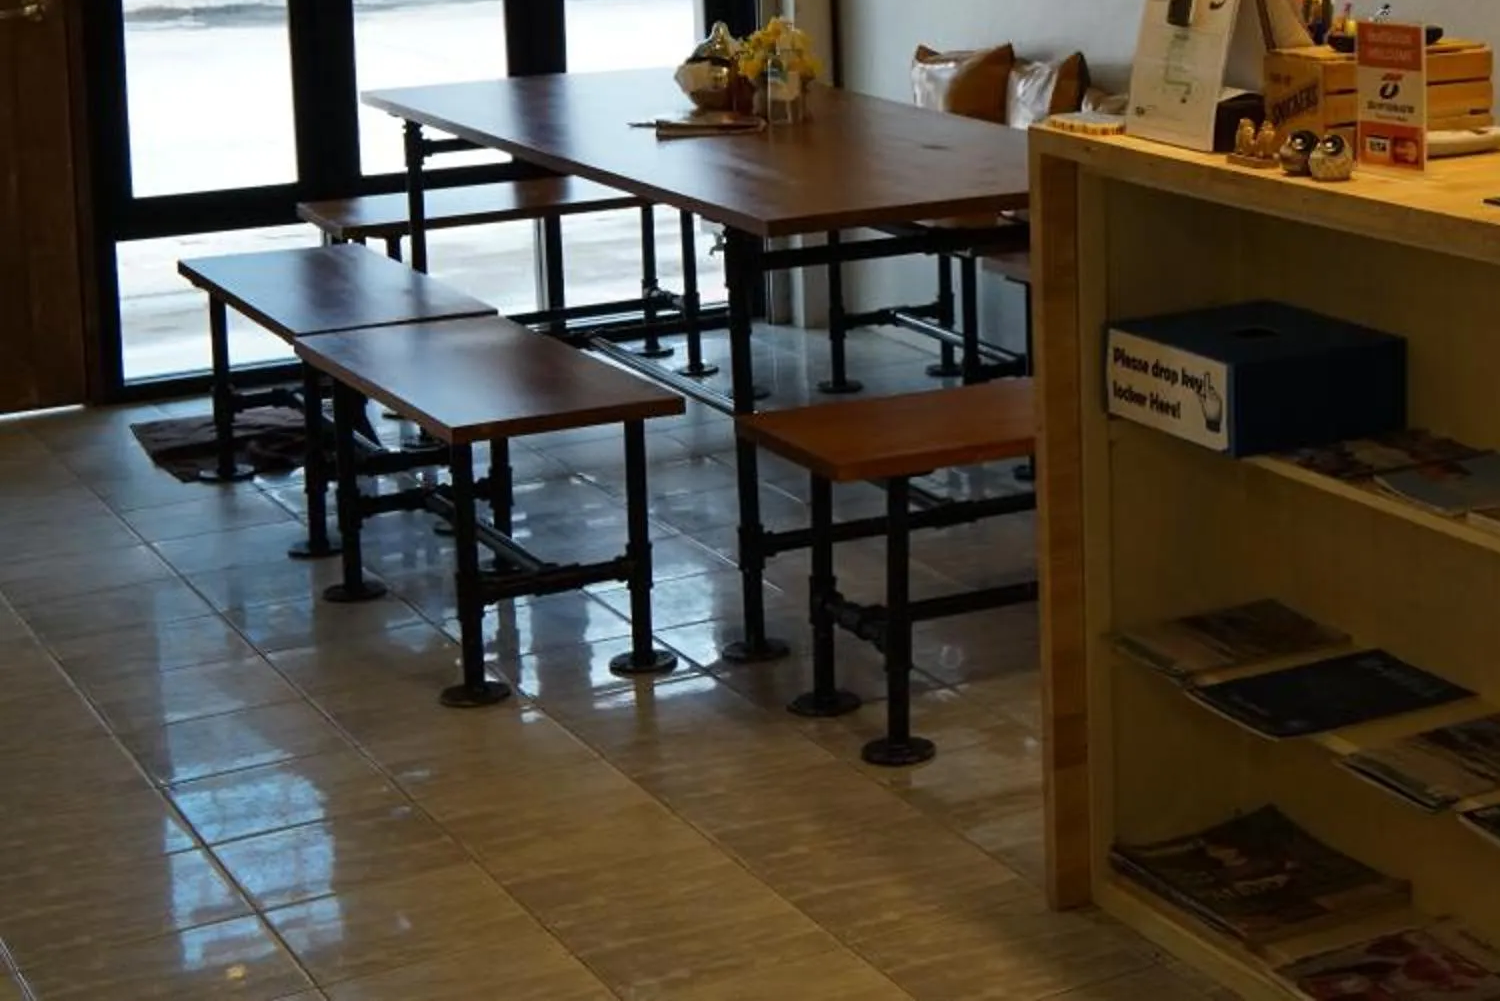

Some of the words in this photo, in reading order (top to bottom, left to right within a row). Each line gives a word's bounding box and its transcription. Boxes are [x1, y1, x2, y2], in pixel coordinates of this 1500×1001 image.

[1113, 346, 1149, 375] Please
[1151, 358, 1179, 386] drop
[1149, 391, 1181, 420] Here!
